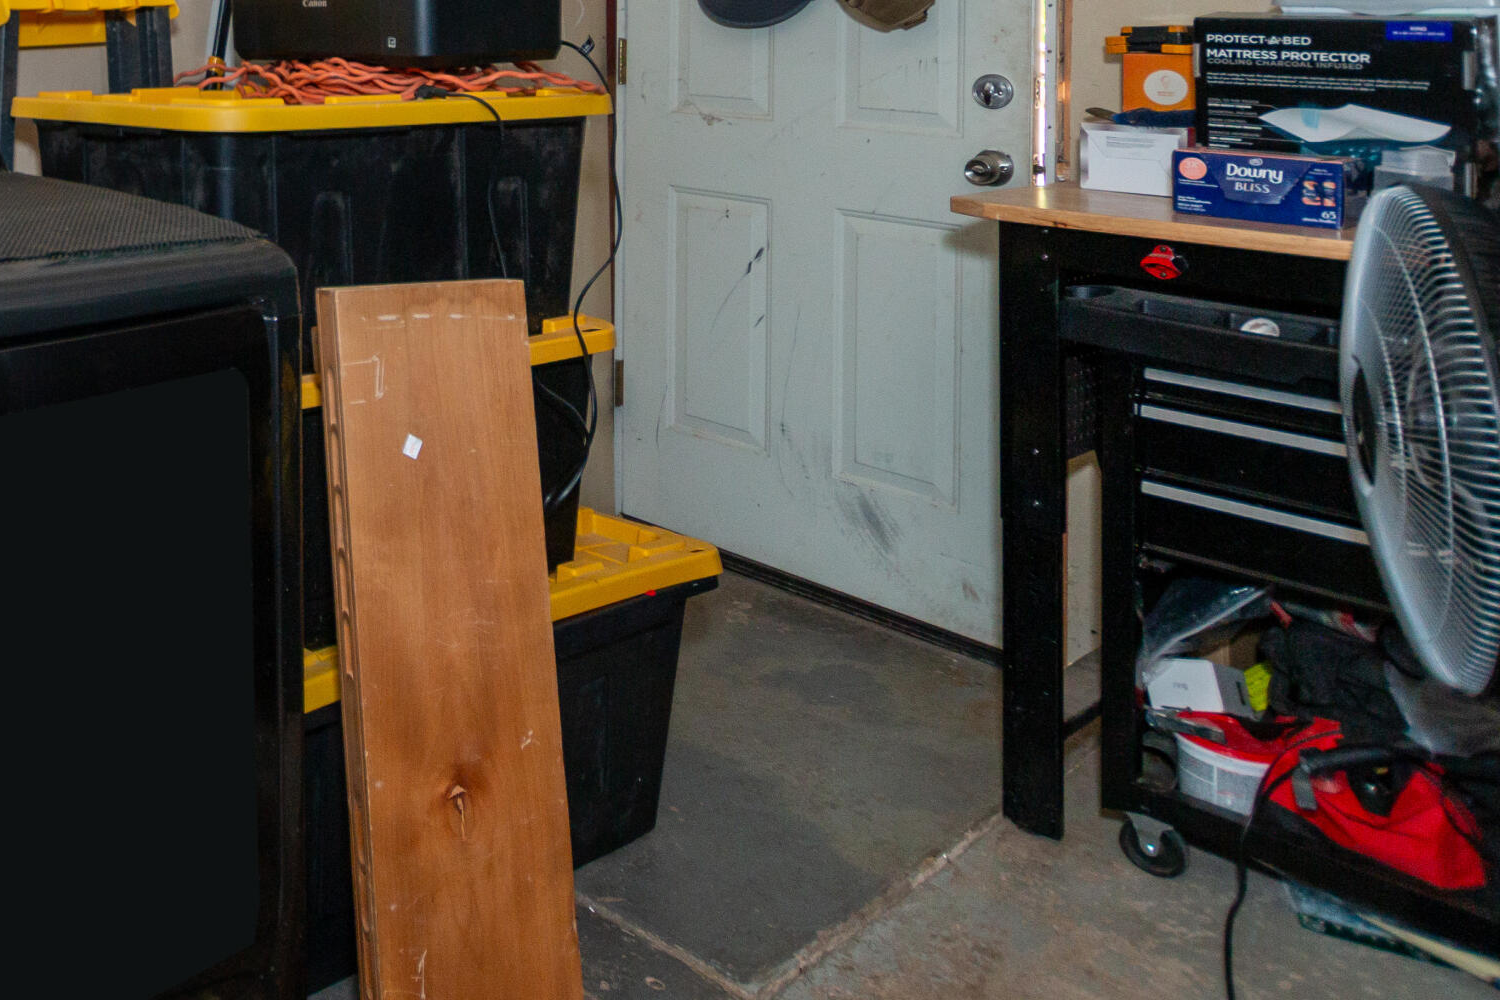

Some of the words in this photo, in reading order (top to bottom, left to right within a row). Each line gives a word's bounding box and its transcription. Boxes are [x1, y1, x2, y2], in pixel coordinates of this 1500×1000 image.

[1206, 48, 1278, 60] MATTRESS
[1281, 51, 1371, 64] PROTECTOR
[1206, 57, 1252, 66] COOLING
[1255, 59, 1313, 69] CHARCOAL
[1316, 62, 1364, 71] INFUSED
[1225, 162, 1284, 185] Downy
[1234, 181, 1271, 194] BLISS
[1321, 211, 1337, 220] 65
